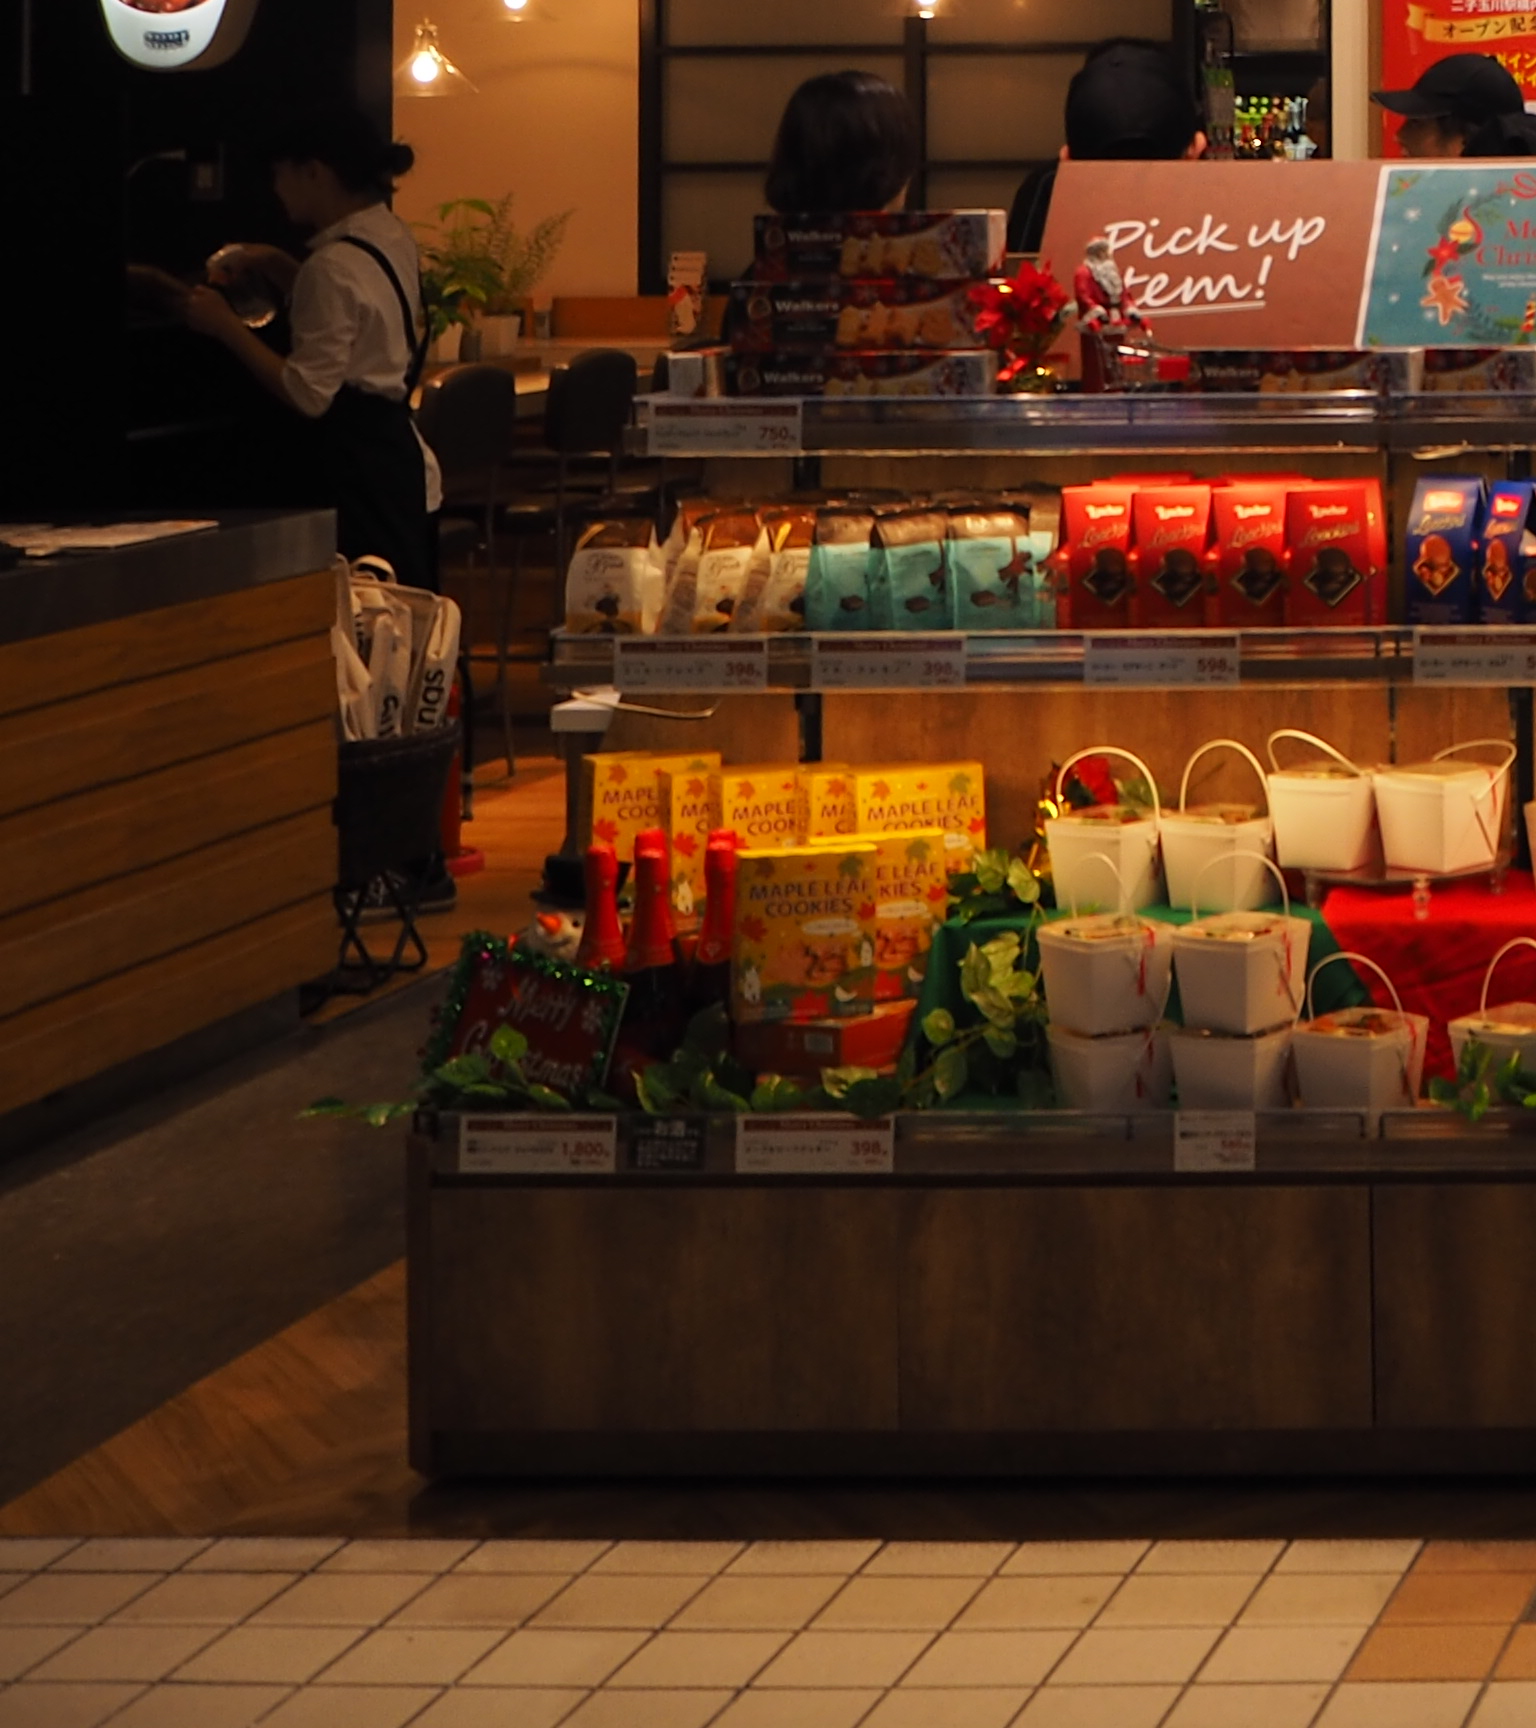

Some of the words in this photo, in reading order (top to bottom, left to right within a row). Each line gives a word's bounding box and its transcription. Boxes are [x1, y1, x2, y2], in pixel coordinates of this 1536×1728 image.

[1104, 213, 1240, 259] Pick
[1248, 216, 1326, 261] up
[774, 300, 840, 312] Walkers
[763, 372, 825, 384] Walkers
[867, 801, 934, 822] MAPLE
[936, 794, 979, 813] LEAF
[890, 862, 939, 880] LEAF
[749, 881, 820, 902] MAPLE
[823, 878, 870, 896] LEAF
[764, 898, 853, 918] COOKIES
